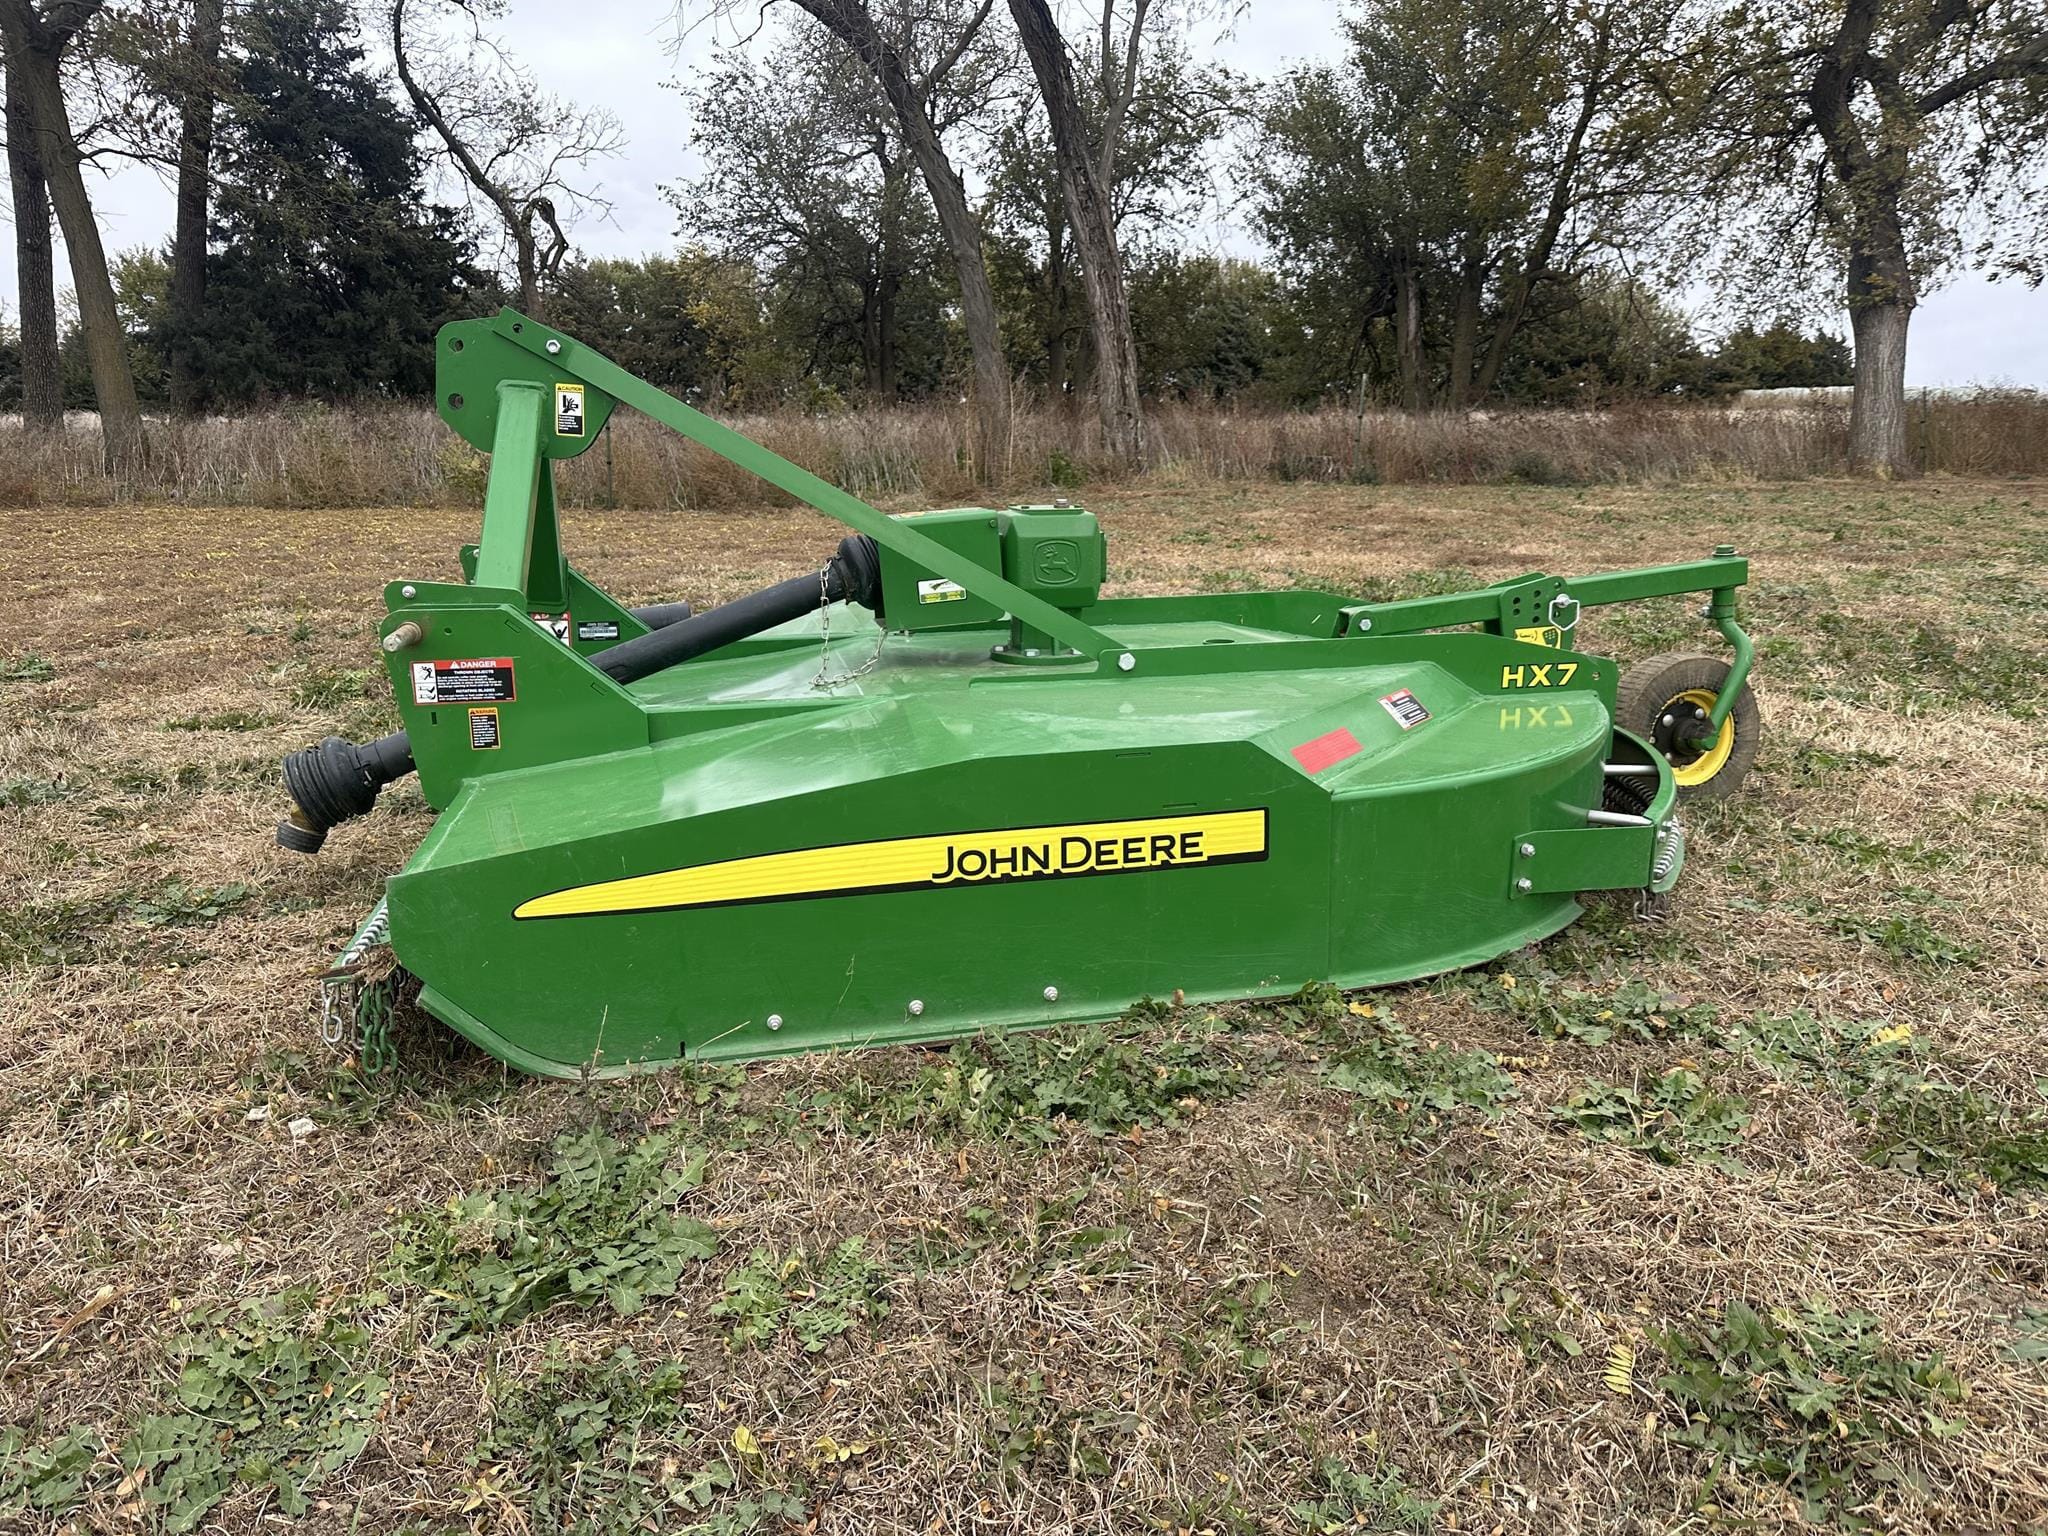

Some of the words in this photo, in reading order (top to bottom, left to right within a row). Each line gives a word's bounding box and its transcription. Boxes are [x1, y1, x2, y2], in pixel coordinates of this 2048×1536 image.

[460, 660, 497, 669] DANGER
[1501, 662, 1578, 689] HX7
[932, 844, 1050, 879] JOHN
[1060, 831, 1204, 869] DEERE
